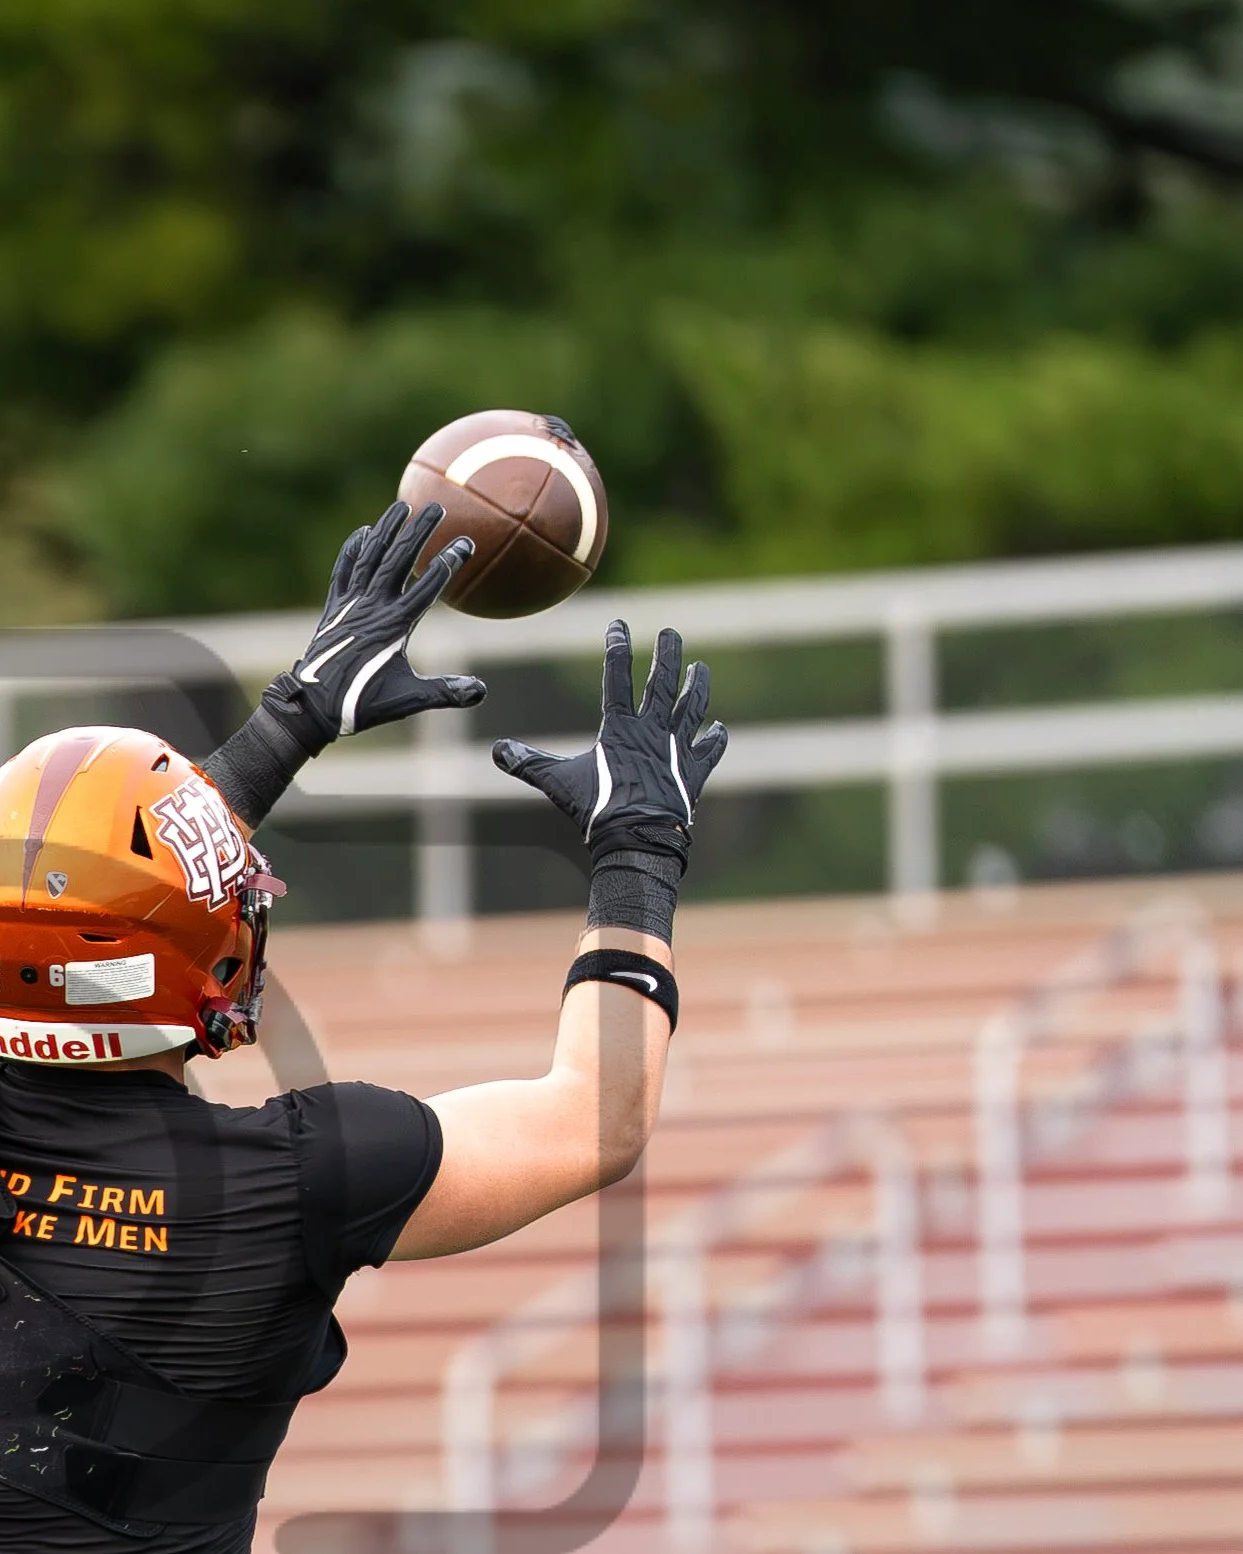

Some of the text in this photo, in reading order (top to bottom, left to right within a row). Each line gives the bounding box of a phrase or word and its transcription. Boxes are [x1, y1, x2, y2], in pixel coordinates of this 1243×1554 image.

[94, 959, 127, 969] WARNING
[0, 1170, 32, 1196] D
[13, 1210, 58, 1240] KE
